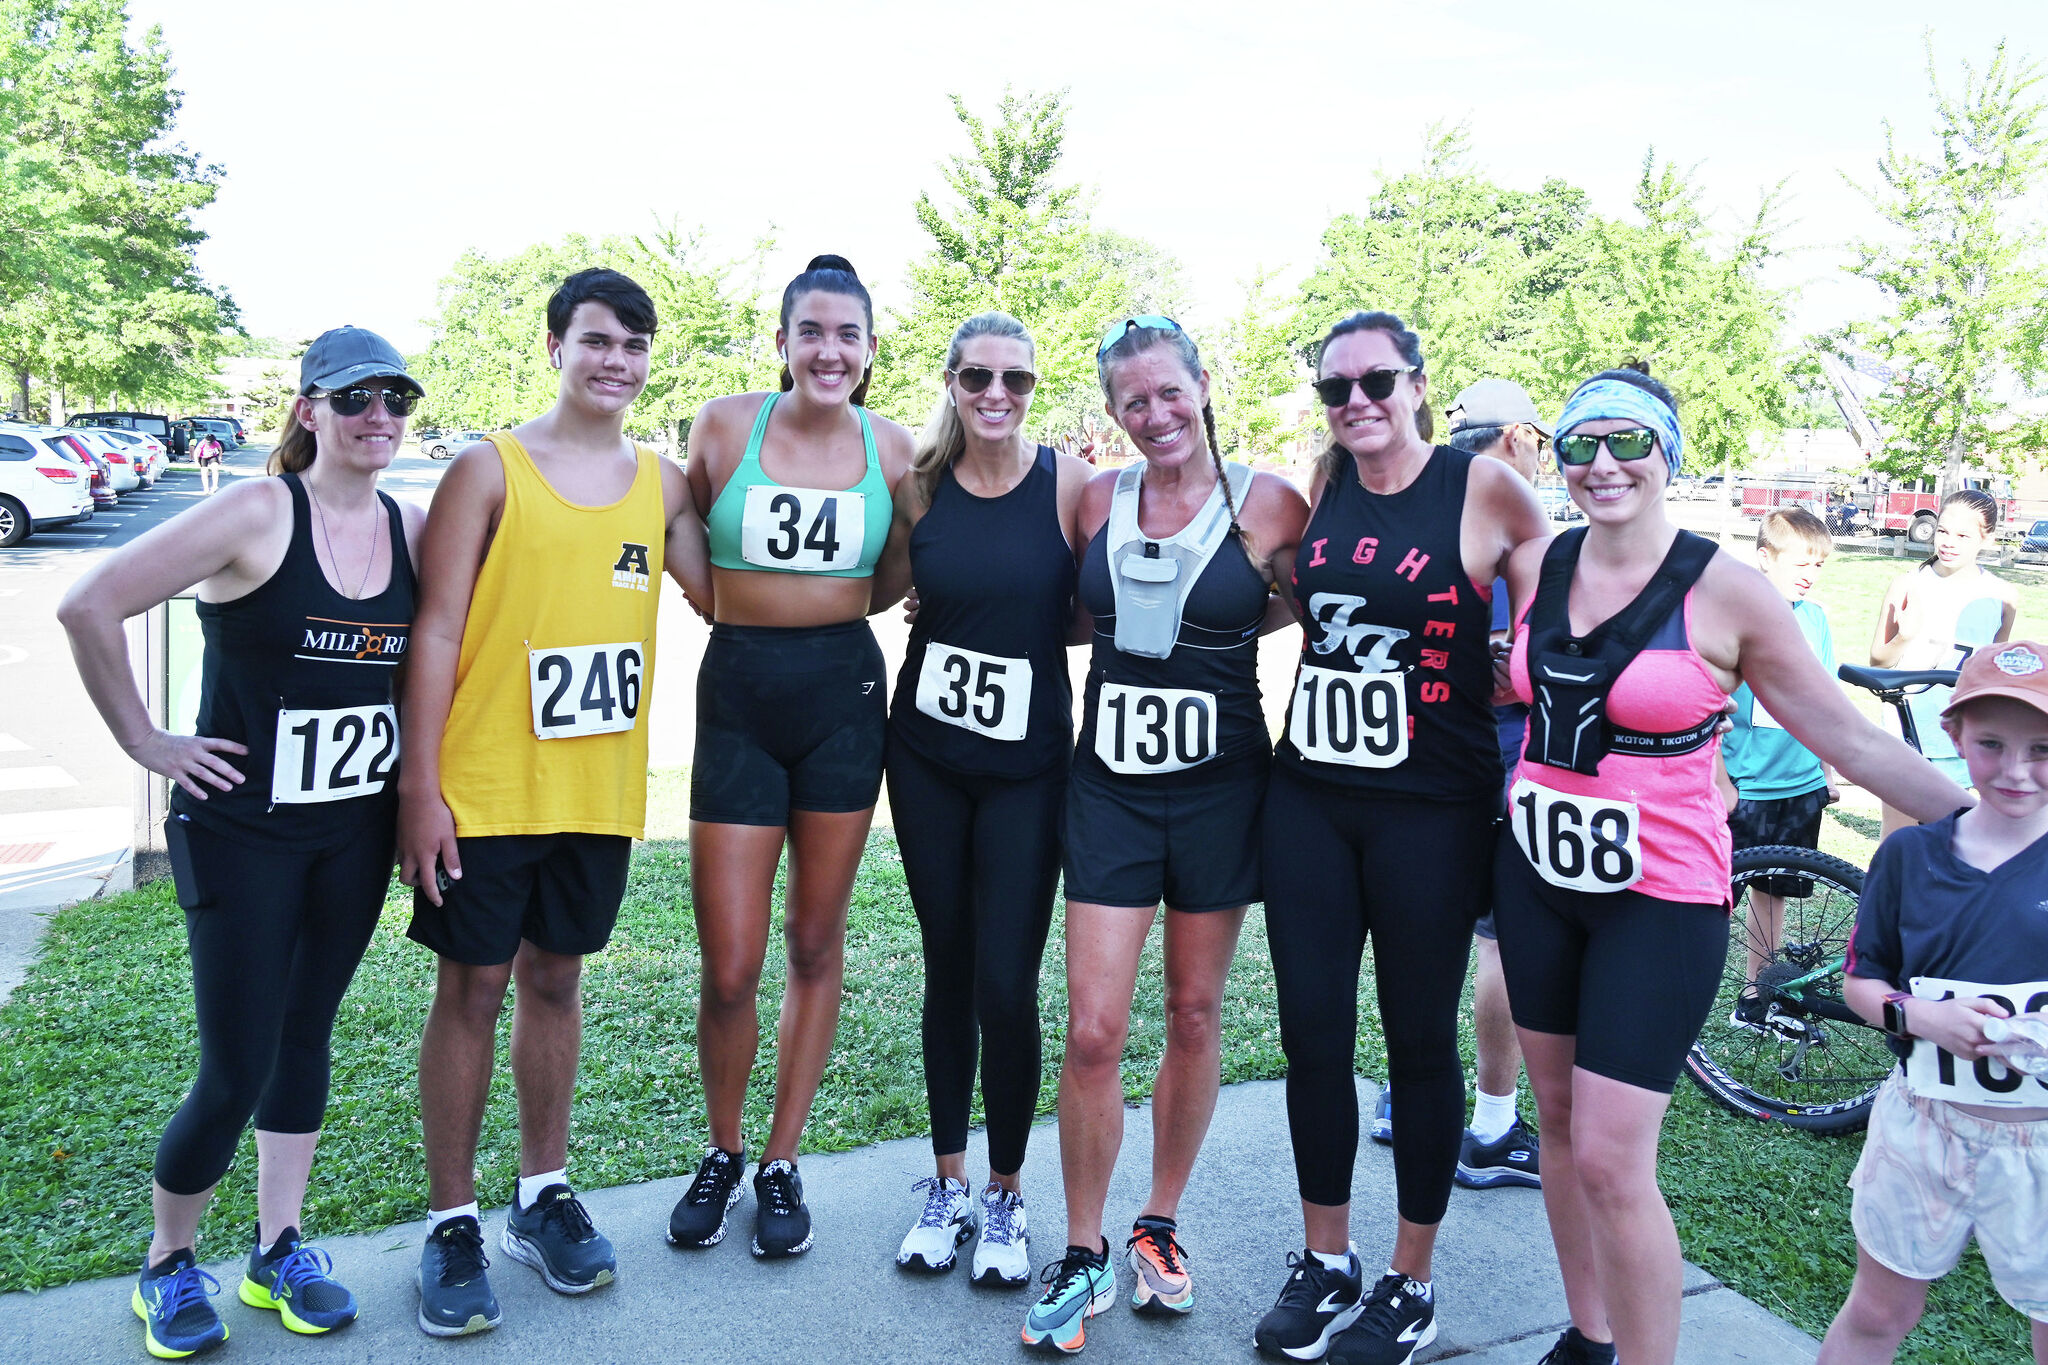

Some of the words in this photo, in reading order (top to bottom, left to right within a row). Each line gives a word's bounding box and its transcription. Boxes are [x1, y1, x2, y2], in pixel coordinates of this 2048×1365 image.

[613, 542, 650, 576] A
[767, 493, 840, 562] 34
[538, 648, 641, 728] 246
[938, 653, 1008, 729] 35
[1303, 674, 1400, 757] 109
[291, 711, 395, 792] 122
[1107, 692, 1210, 766] 130
[1517, 790, 1634, 884] 168
